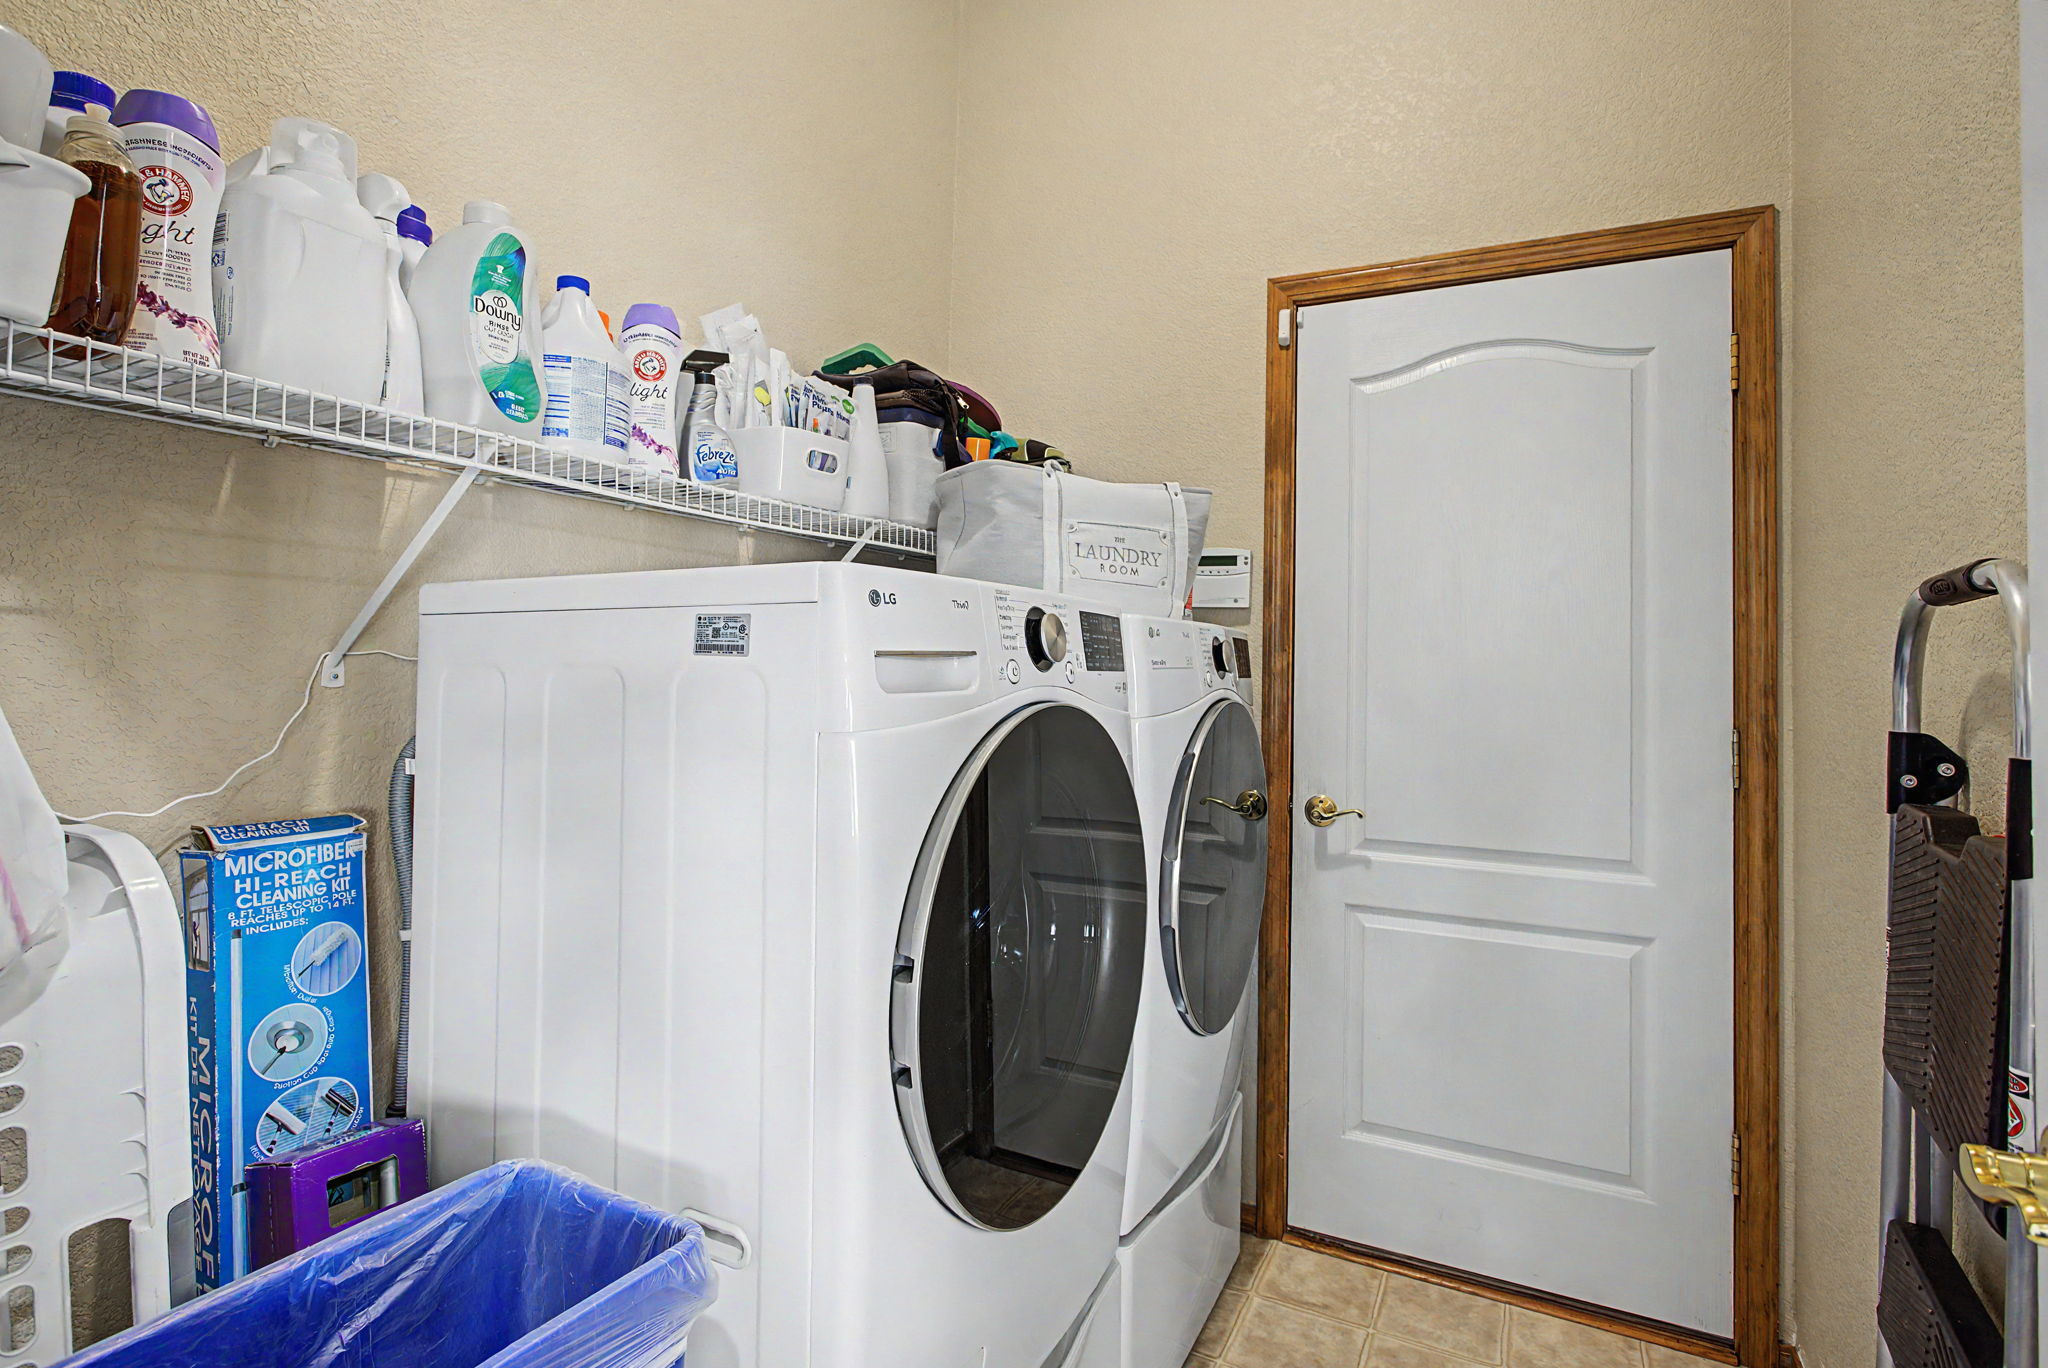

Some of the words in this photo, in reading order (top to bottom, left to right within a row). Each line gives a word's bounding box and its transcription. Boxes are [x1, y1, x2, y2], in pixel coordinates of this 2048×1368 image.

[155, 168, 191, 202] HAMMER
[474, 297, 521, 332] Downy
[488, 320, 510, 332] RINSE
[629, 382, 668, 402] light
[1074, 542, 1162, 568] LAUNDRY
[1114, 536, 1126, 544] THE
[1099, 563, 1140, 577] ROOM
[883, 592, 897, 605] LG
[212, 819, 310, 836] HI-REACH
[220, 827, 291, 841] CLEANING
[290, 825, 311, 834] KIT
[225, 839, 357, 878] MICROFIBER
[235, 861, 351, 894] HI-REACH
[228, 912, 235, 920] 8
[240, 909, 256, 919] FT.
[261, 895, 329, 915] TELESCOPIC
[332, 889, 357, 901] POLE
[236, 881, 328, 910] CLEANING
[331, 876, 351, 893] KIT
[231, 911, 288, 928] REACHES
[292, 908, 306, 917] UP
[310, 905, 324, 913] TO
[327, 900, 340, 910] 14
[342, 898, 355, 907] FT.
[245, 918, 309, 936] INCLUDES:
[189, 996, 198, 1037] KIT
[190, 1046, 199, 1085] DE
[191, 1097, 203, 1272] NETTOYAGE
